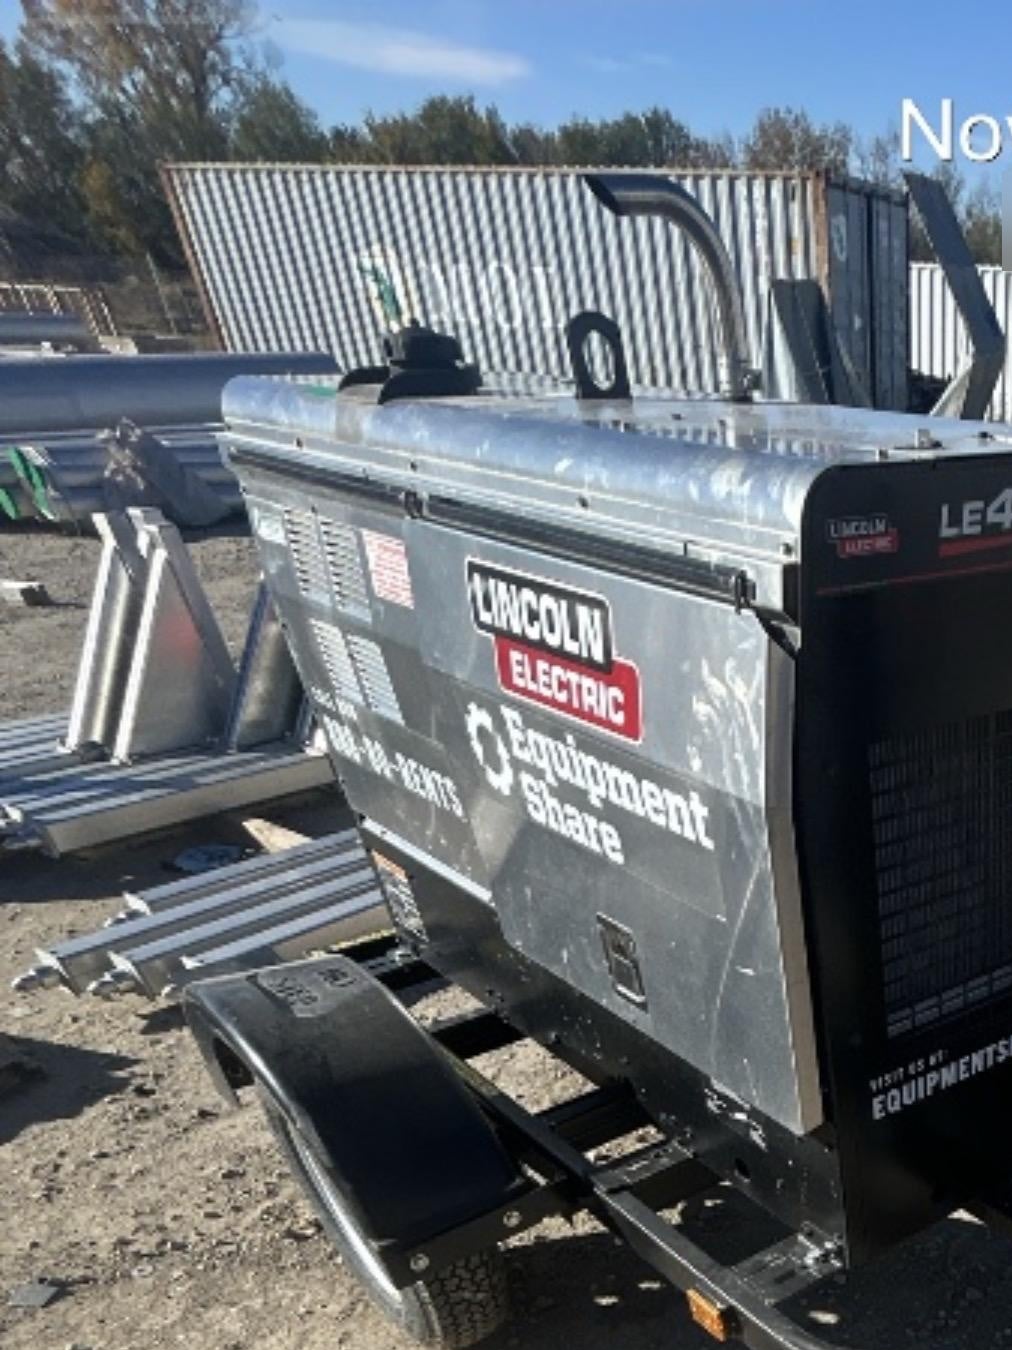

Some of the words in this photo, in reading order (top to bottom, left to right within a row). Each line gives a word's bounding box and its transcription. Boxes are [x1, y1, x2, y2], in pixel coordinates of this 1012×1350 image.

[473, 571, 605, 665] LINCOLN
[509, 649, 626, 726] ELECTRIC
[499, 704, 715, 851] Equipment
[518, 770, 625, 866] Share
